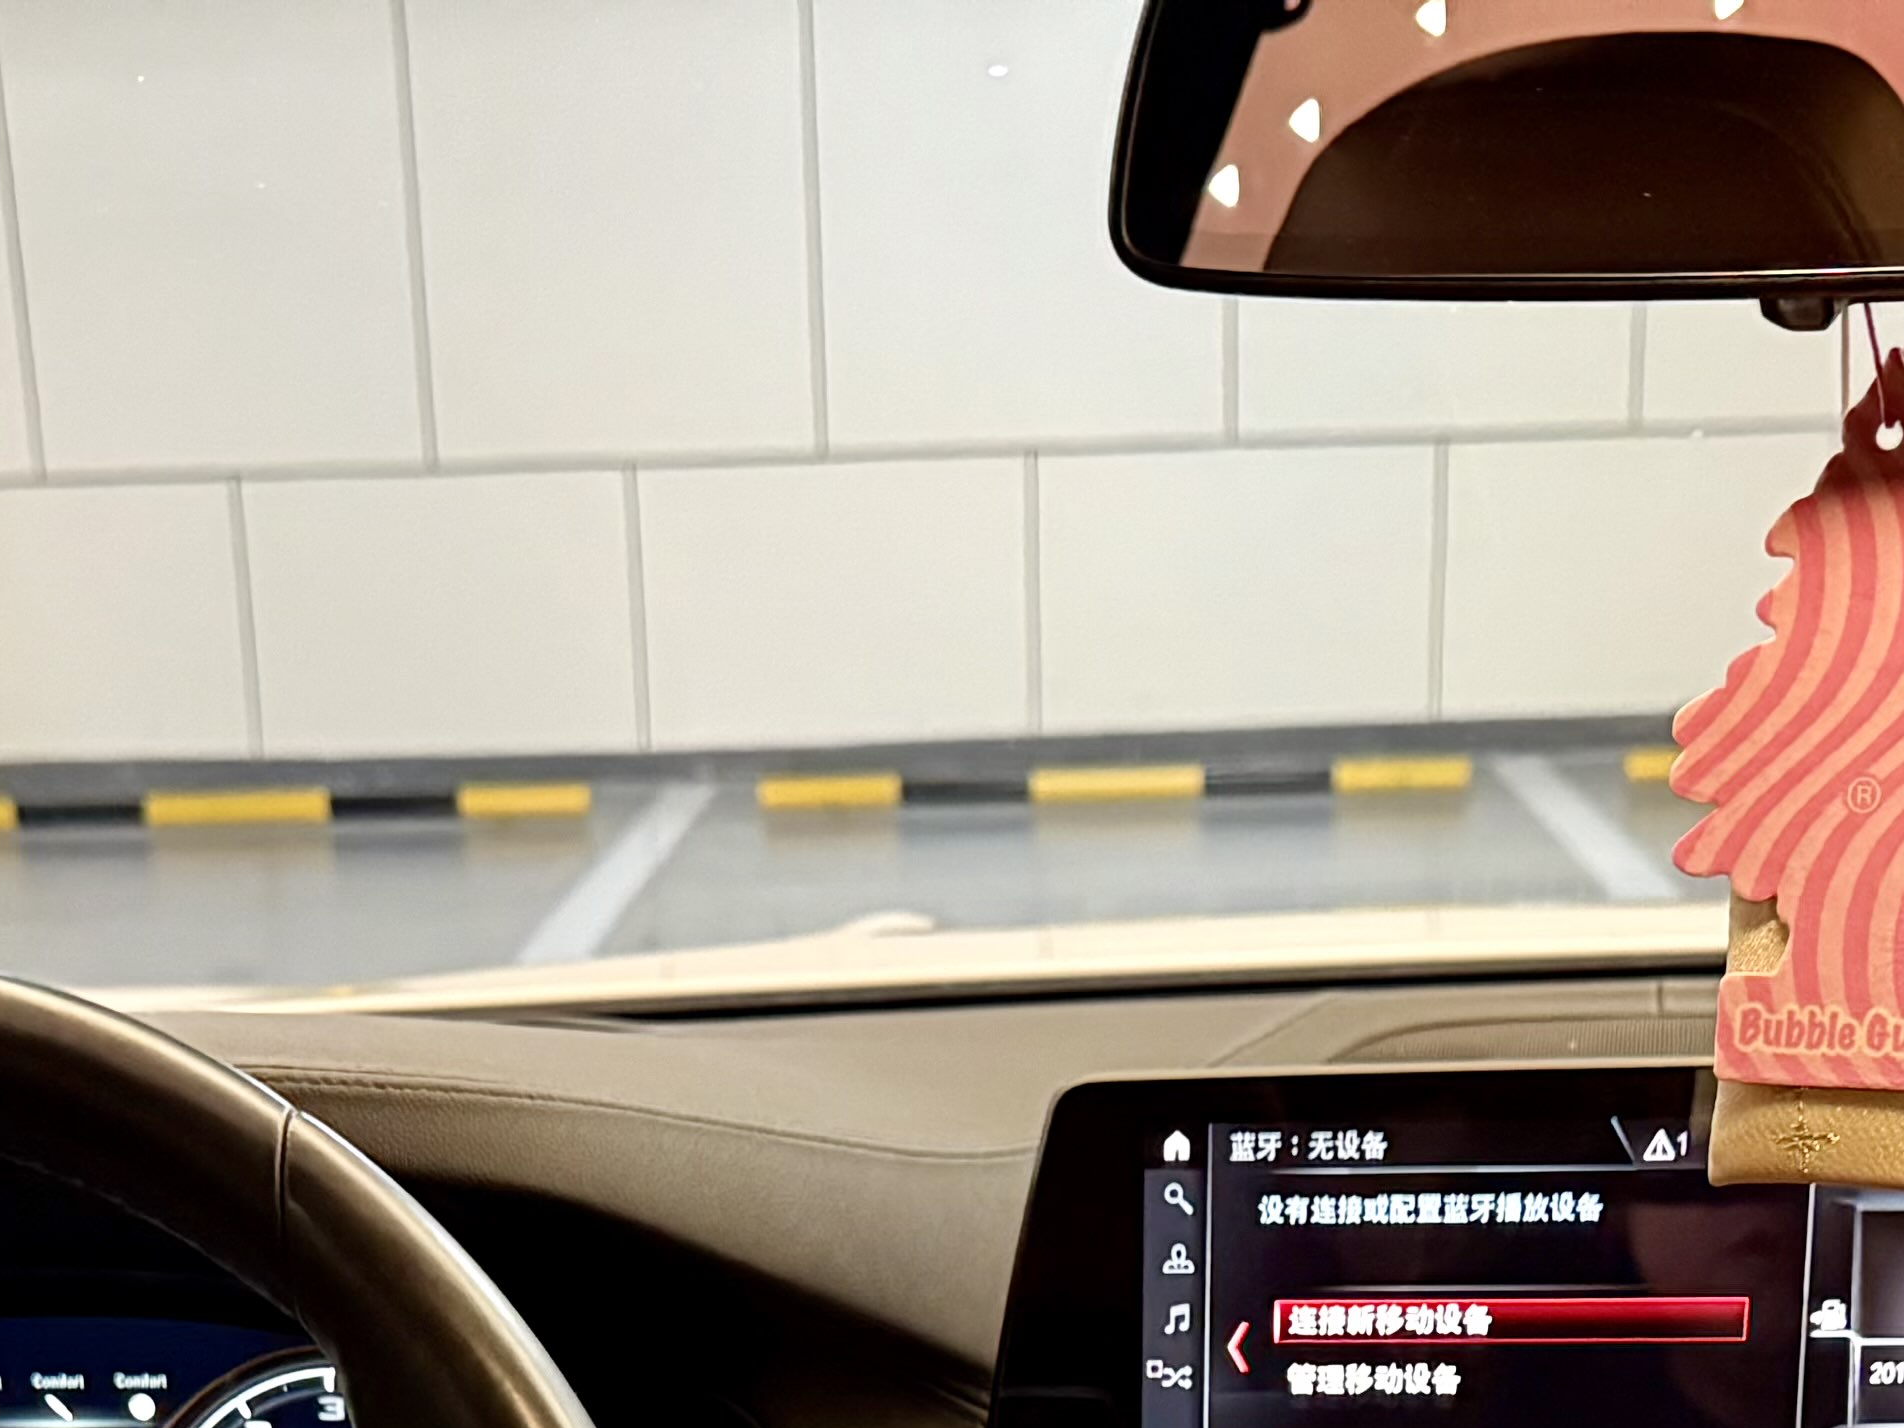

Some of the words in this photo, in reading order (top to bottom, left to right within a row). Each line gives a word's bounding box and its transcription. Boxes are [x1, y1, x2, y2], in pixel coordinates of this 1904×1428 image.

[1737, 1006, 1858, 1053] Bubble
[1258, 1193, 1603, 1225] 没有连接或配置蓝牙播放设备
[1288, 1304, 1492, 1337] 连接新移动设备
[1286, 1363, 1461, 1396] 管理移动设备
[1869, 1361, 1904, 1385] 201
[317, 1396, 345, 1421] 3
